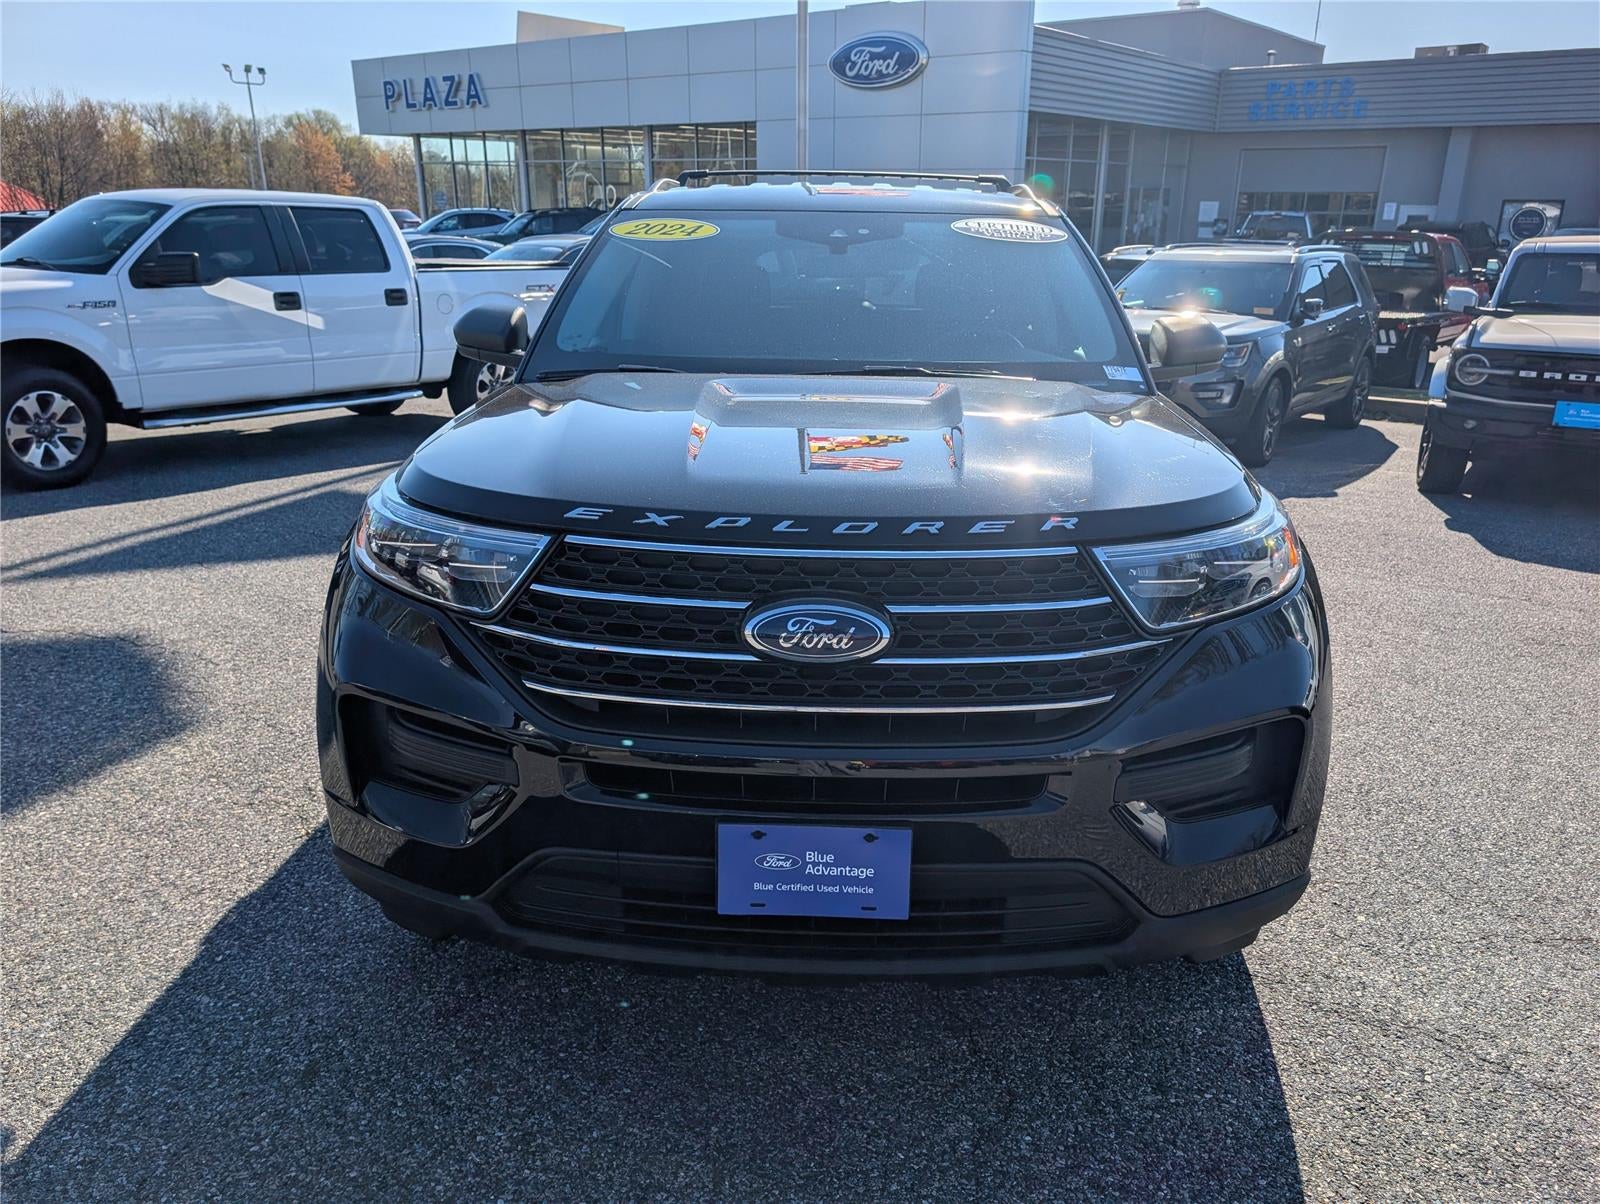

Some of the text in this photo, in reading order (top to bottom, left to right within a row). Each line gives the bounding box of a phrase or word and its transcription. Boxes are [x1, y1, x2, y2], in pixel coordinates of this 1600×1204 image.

[845, 46, 900, 78] Ford
[383, 73, 484, 110] PLAZA
[1266, 77, 1354, 97] PARTS
[1247, 98, 1369, 120] SERVICE
[624, 222, 705, 237] 2024
[563, 507, 1080, 533] EXPLORER
[779, 616, 856, 650] Ford
[763, 851, 835, 868] Ford Blue
[805, 864, 875, 879] Advantage
[753, 882, 875, 894] Blue Certified Used Vehicle
